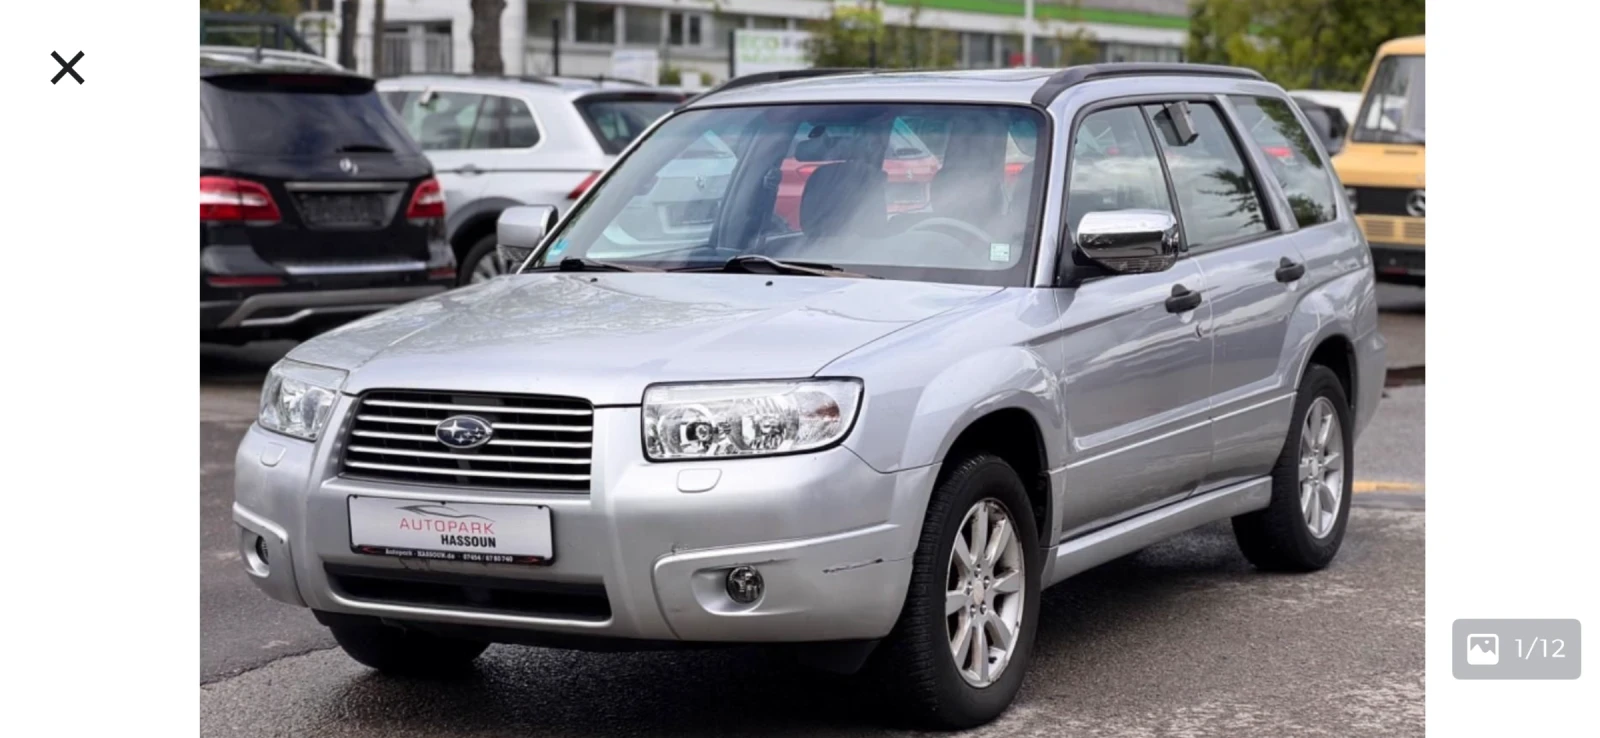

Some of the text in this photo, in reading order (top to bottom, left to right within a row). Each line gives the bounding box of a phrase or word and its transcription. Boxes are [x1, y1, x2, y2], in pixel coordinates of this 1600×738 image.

[399, 518, 495, 535] AUTOPARK
[440, 534, 497, 548] HASSOUN
[385, 548, 412, 557] Autopark
